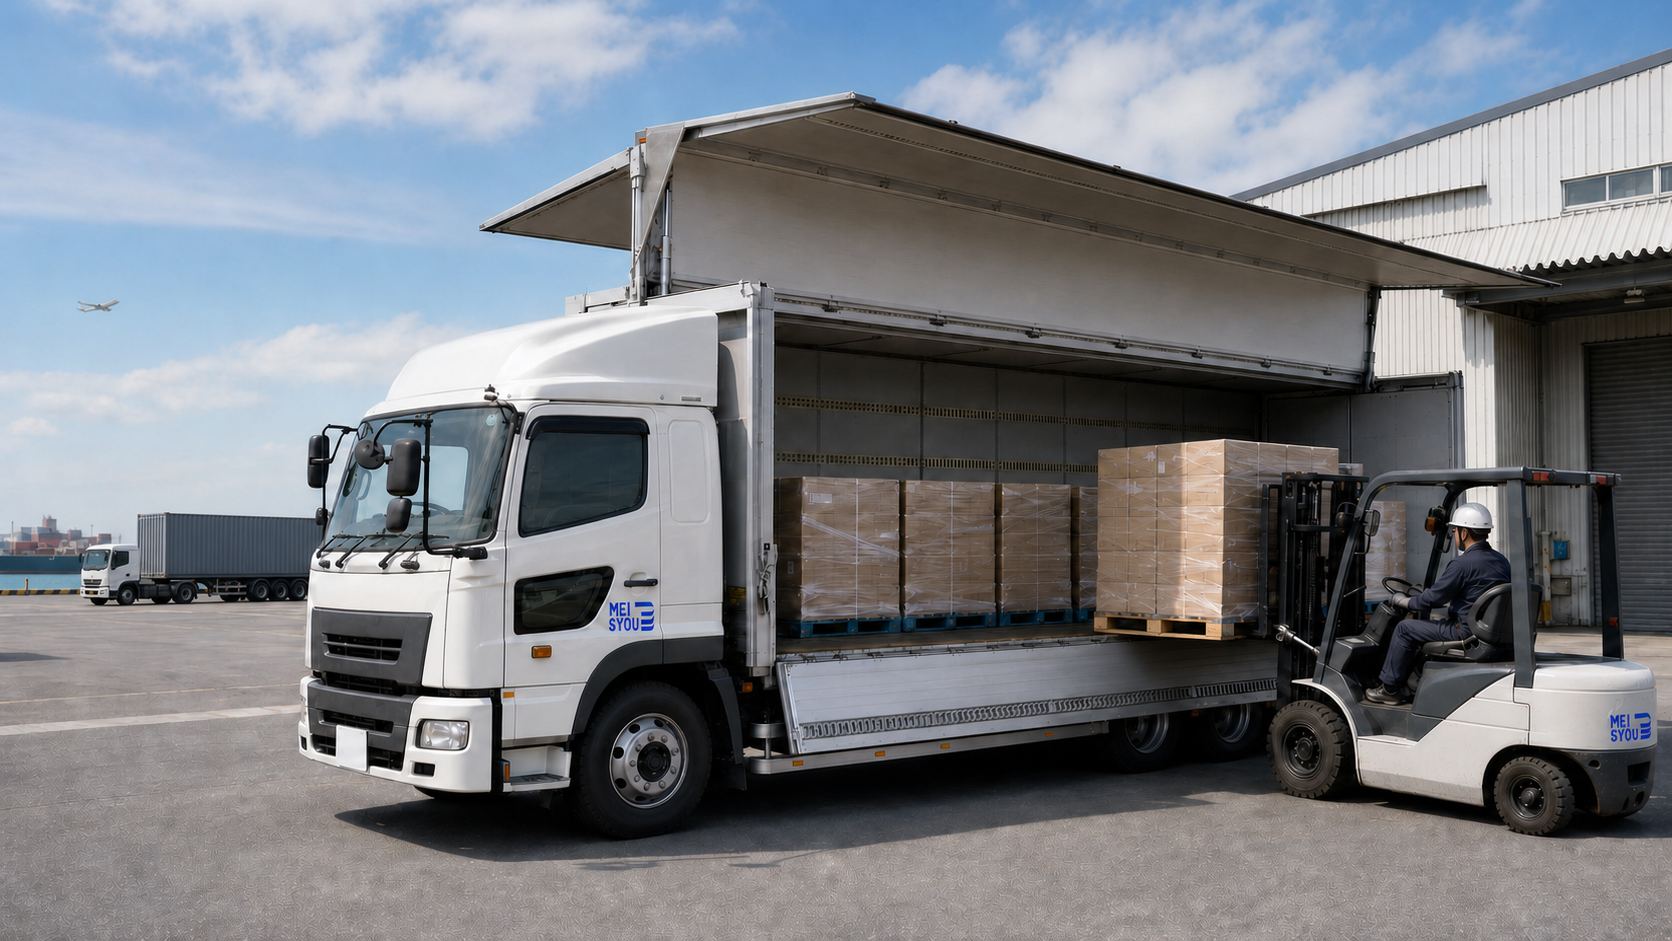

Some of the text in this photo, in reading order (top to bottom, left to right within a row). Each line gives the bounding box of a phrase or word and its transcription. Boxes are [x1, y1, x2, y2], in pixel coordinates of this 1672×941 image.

[609, 602, 630, 616] MEI
[609, 617, 639, 631] SYOU
[1610, 714, 1630, 728] MEI
[1611, 728, 1638, 742] SYOU
